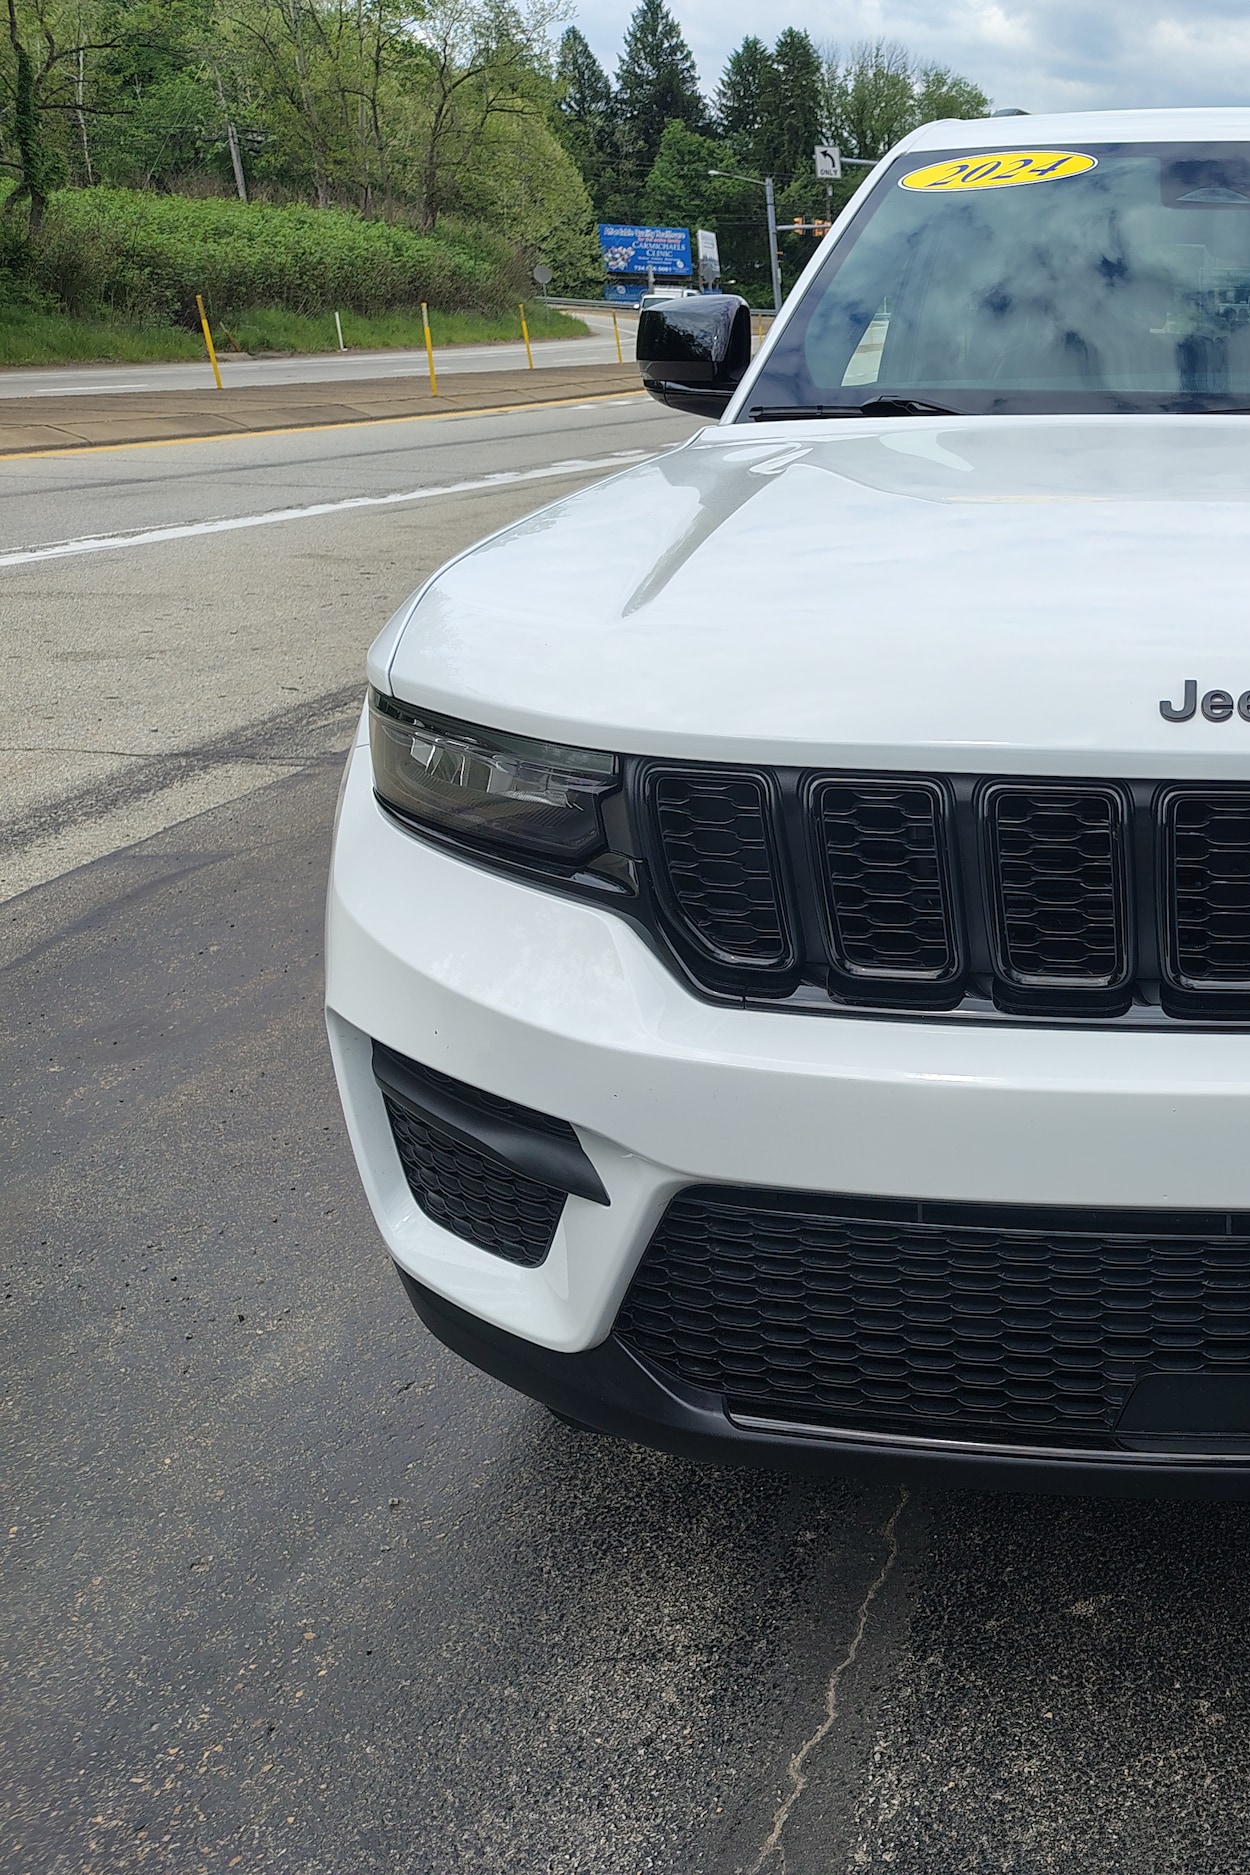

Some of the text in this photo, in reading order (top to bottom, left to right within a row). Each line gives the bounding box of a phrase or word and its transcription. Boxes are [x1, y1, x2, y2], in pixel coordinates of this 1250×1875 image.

[820, 168, 838, 176] ONLY
[924, 156, 1074, 188] 2024
[646, 249, 673, 257] CLINIC
